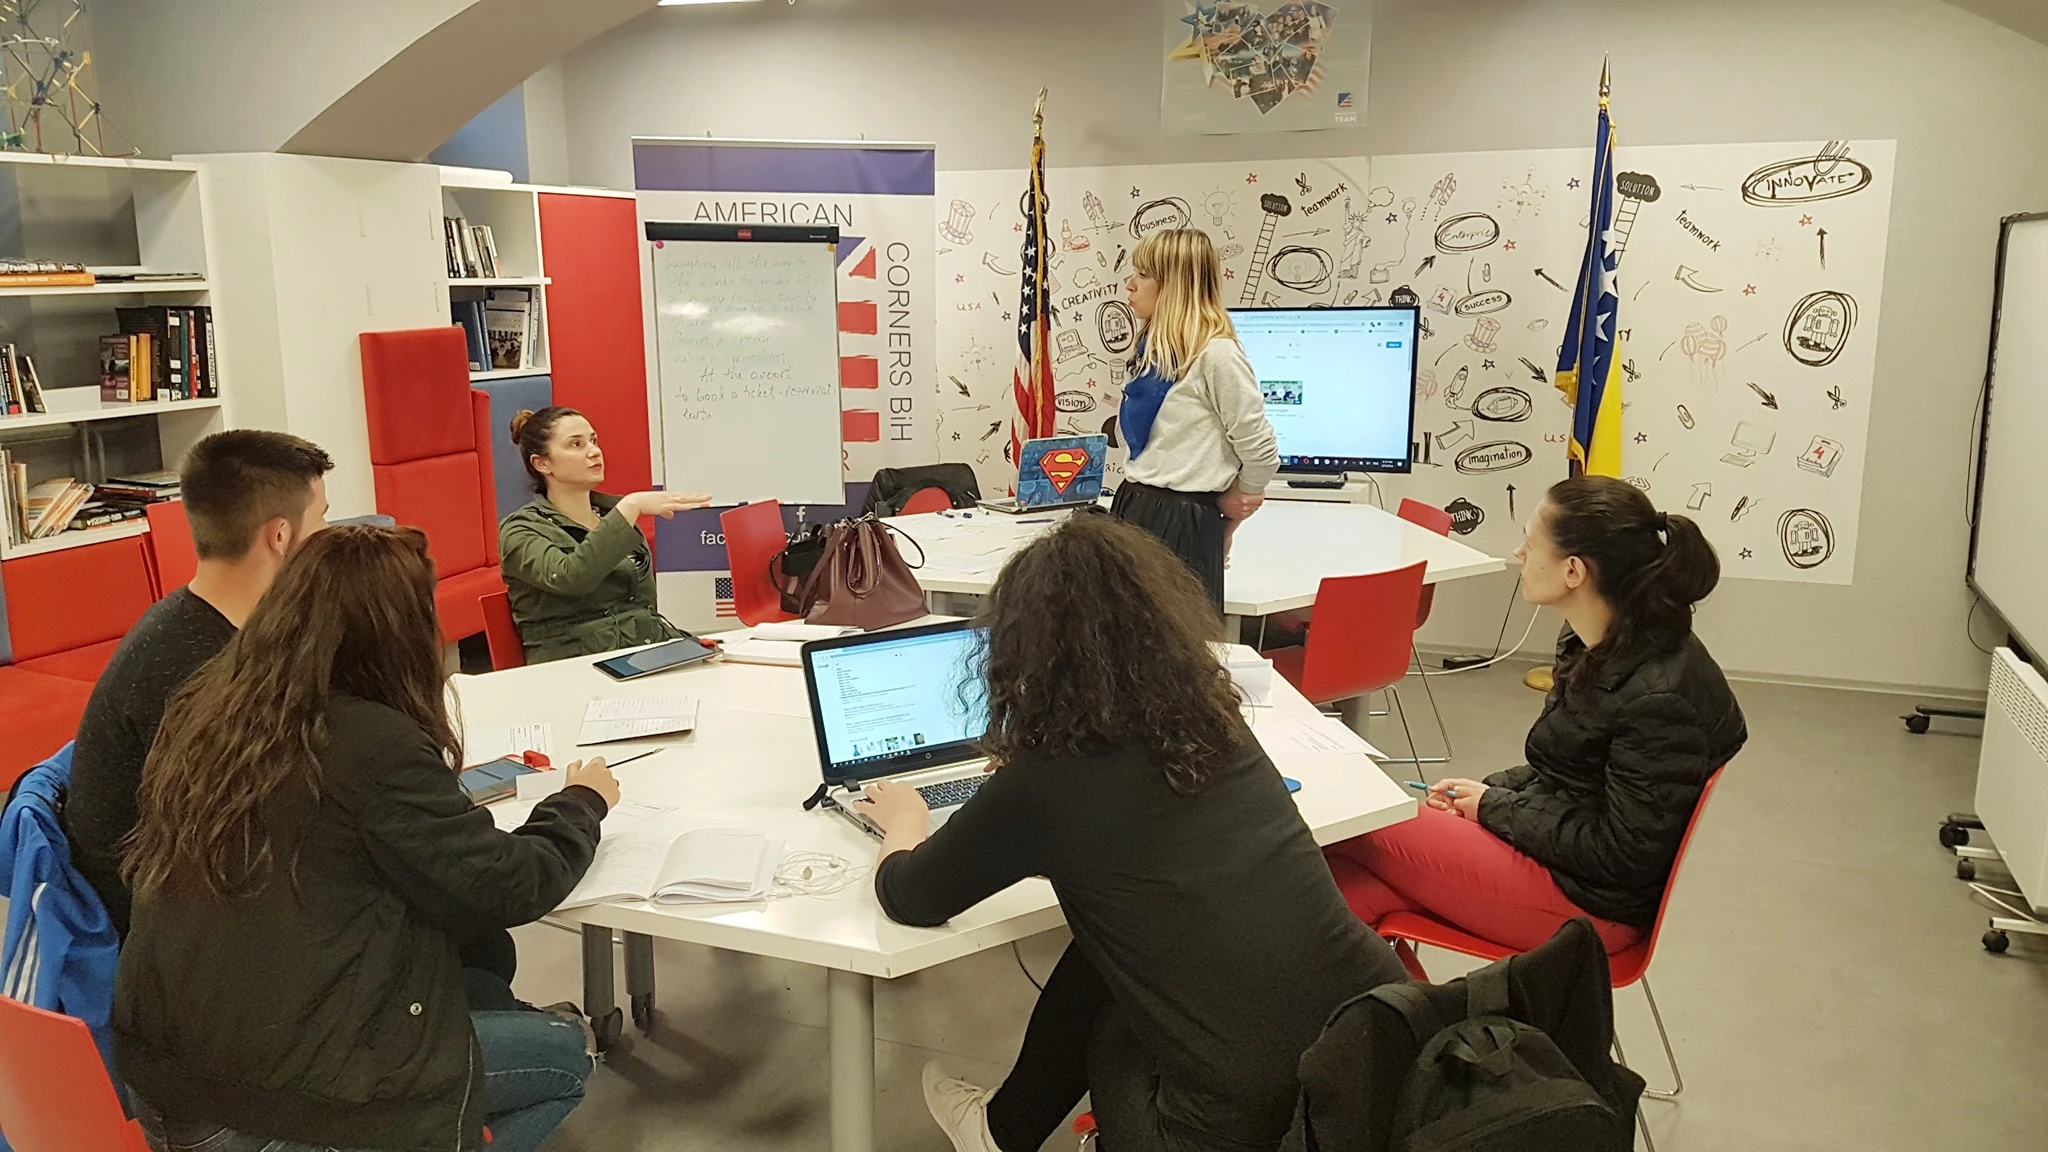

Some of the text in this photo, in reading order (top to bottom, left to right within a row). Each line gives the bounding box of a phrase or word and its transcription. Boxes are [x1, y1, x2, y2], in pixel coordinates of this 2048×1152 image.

[1620, 181, 1655, 196] SOLUTION
[1766, 170, 1848, 199] INNOVATE
[1300, 183, 1349, 217] teamwork
[694, 201, 852, 227] AMERICAN
[1139, 214, 1178, 231] business
[1676, 209, 1722, 252] teamwork
[1062, 283, 1118, 310] CREATIVITY
[1465, 295, 1502, 310] SUCCESS
[957, 303, 982, 311] USA
[887, 242, 913, 441] CORNERS BiH
[1057, 397, 1086, 408] vision
[1544, 432, 1566, 443] US
[1468, 449, 1523, 467] imagination
[1813, 446, 1824, 460] 4
[700, 530, 727, 545] fac
